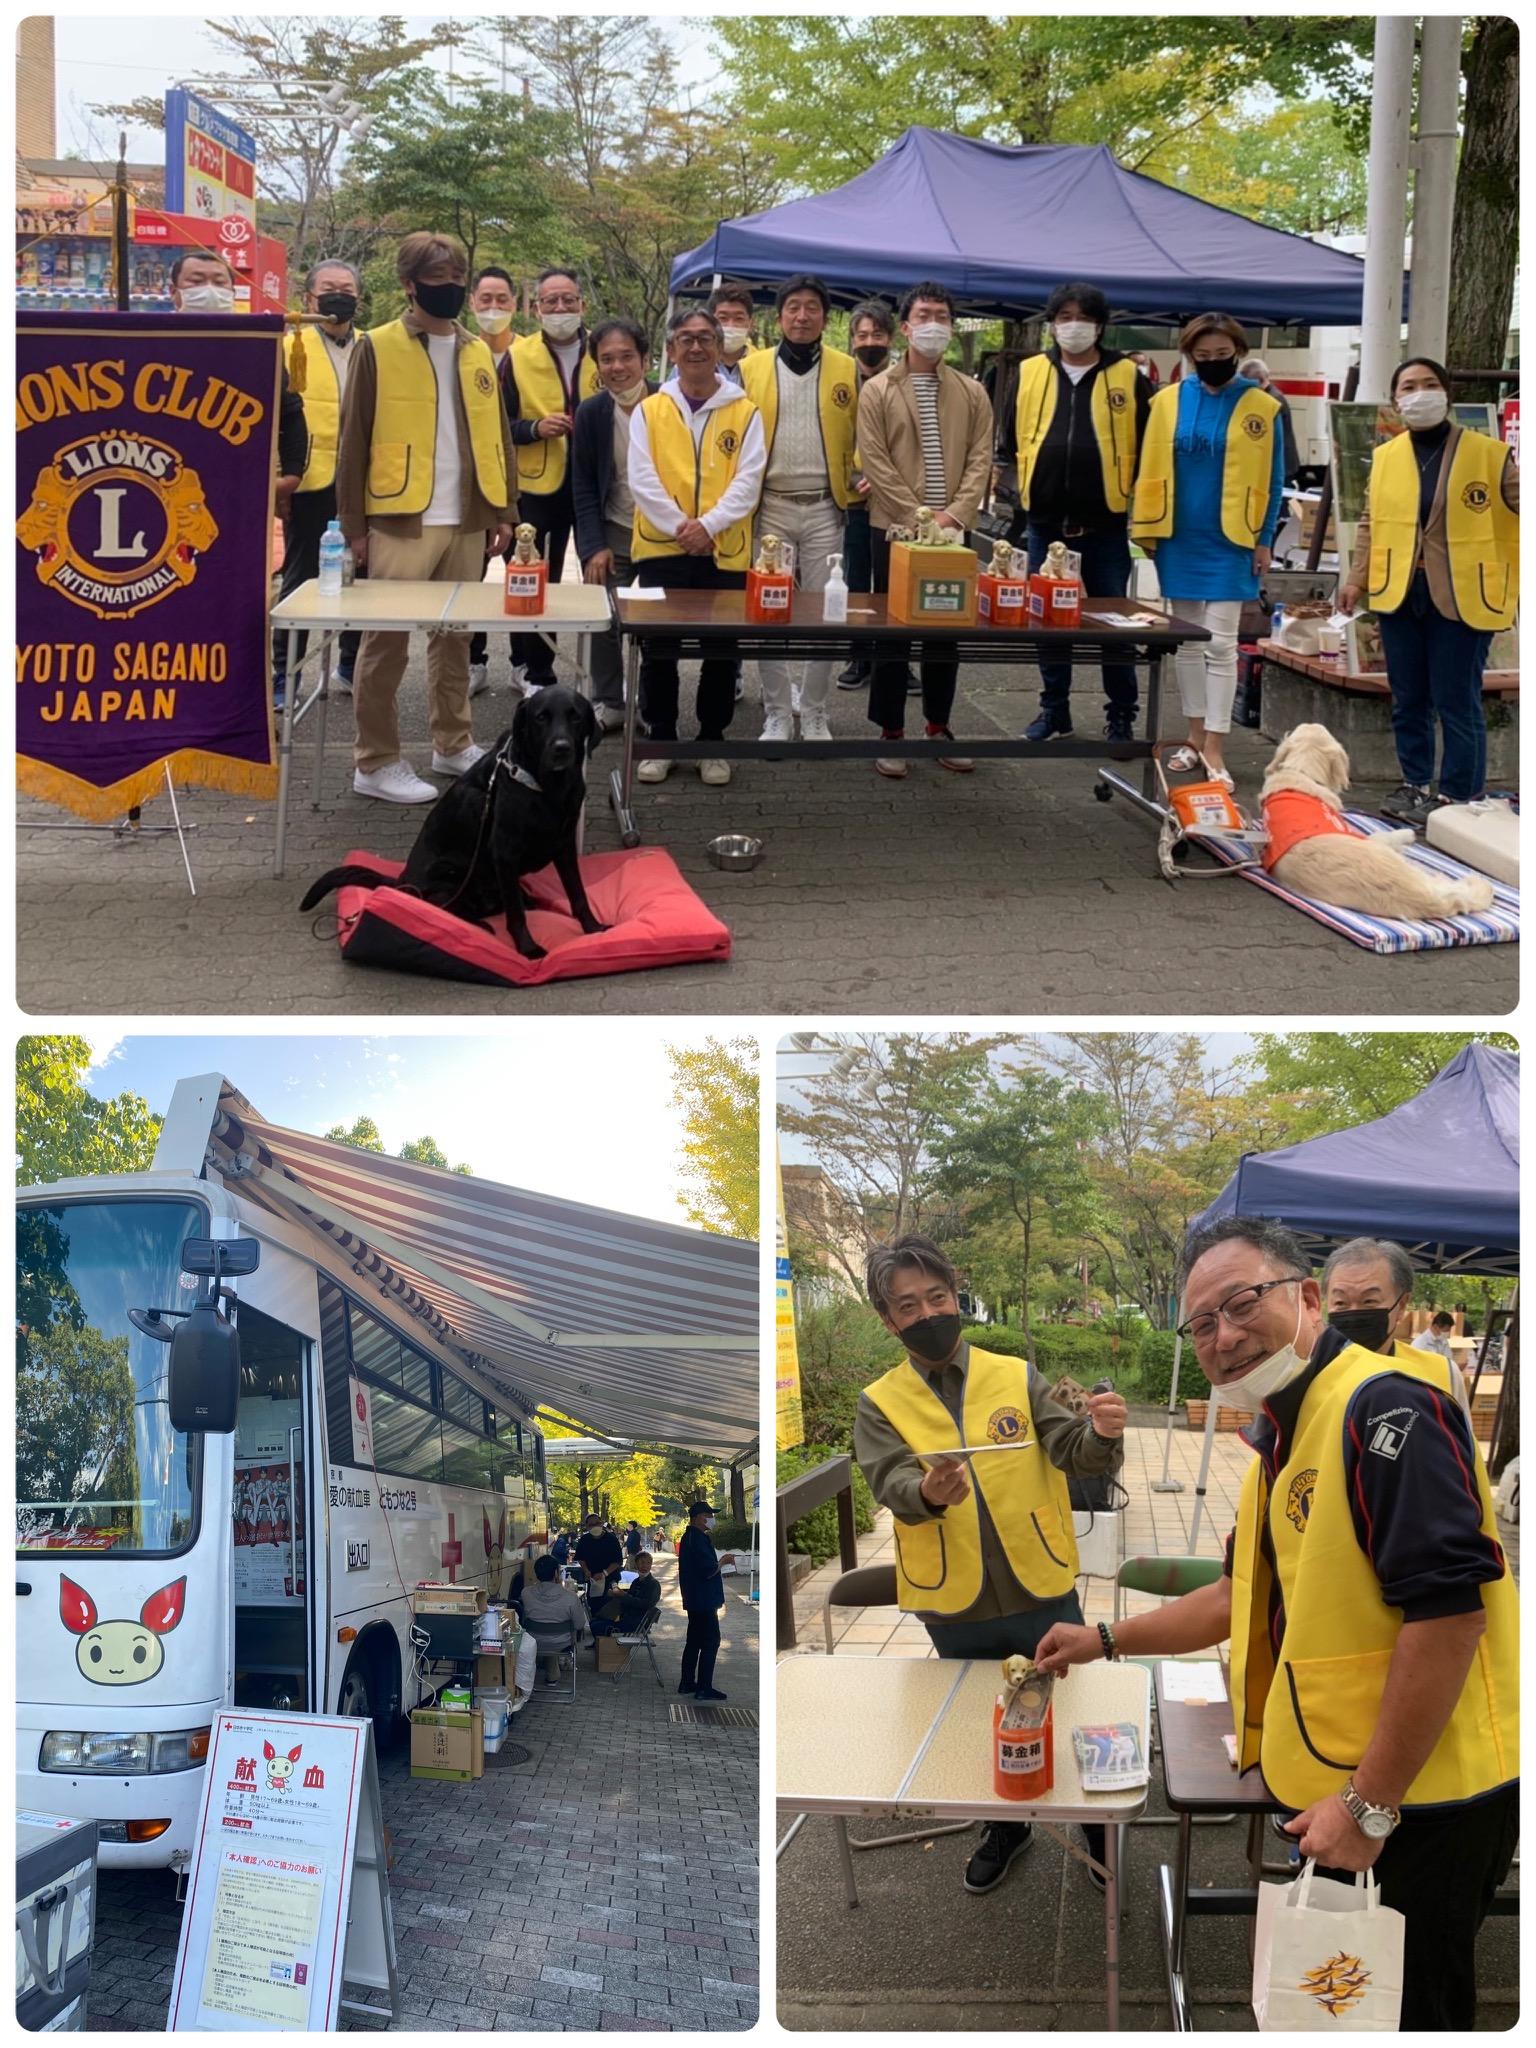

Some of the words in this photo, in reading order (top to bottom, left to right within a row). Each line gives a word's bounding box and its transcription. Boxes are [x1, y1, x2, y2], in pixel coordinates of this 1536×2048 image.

[133, 362, 264, 446] CLUB
[63, 439, 172, 477] LIONS
[93, 488, 148, 557] L
[54, 564, 178, 604] INTERNATIONAL
[113, 642, 227, 683] SAGANO
[40, 688, 177, 722] JAPAN
[1001, 1419, 1017, 1435] L
[329, 1485, 371, 1508] 愛の献血車
[379, 1487, 417, 1511] ともづな2号
[349, 1543, 368, 1567] 出入口
[1002, 1742, 1041, 1759] 募金箱
[235, 1757, 257, 1781] 献
[303, 1765, 325, 1789] 血
[225, 1851, 322, 1875] 「本人確認」へのご協力のお願い
